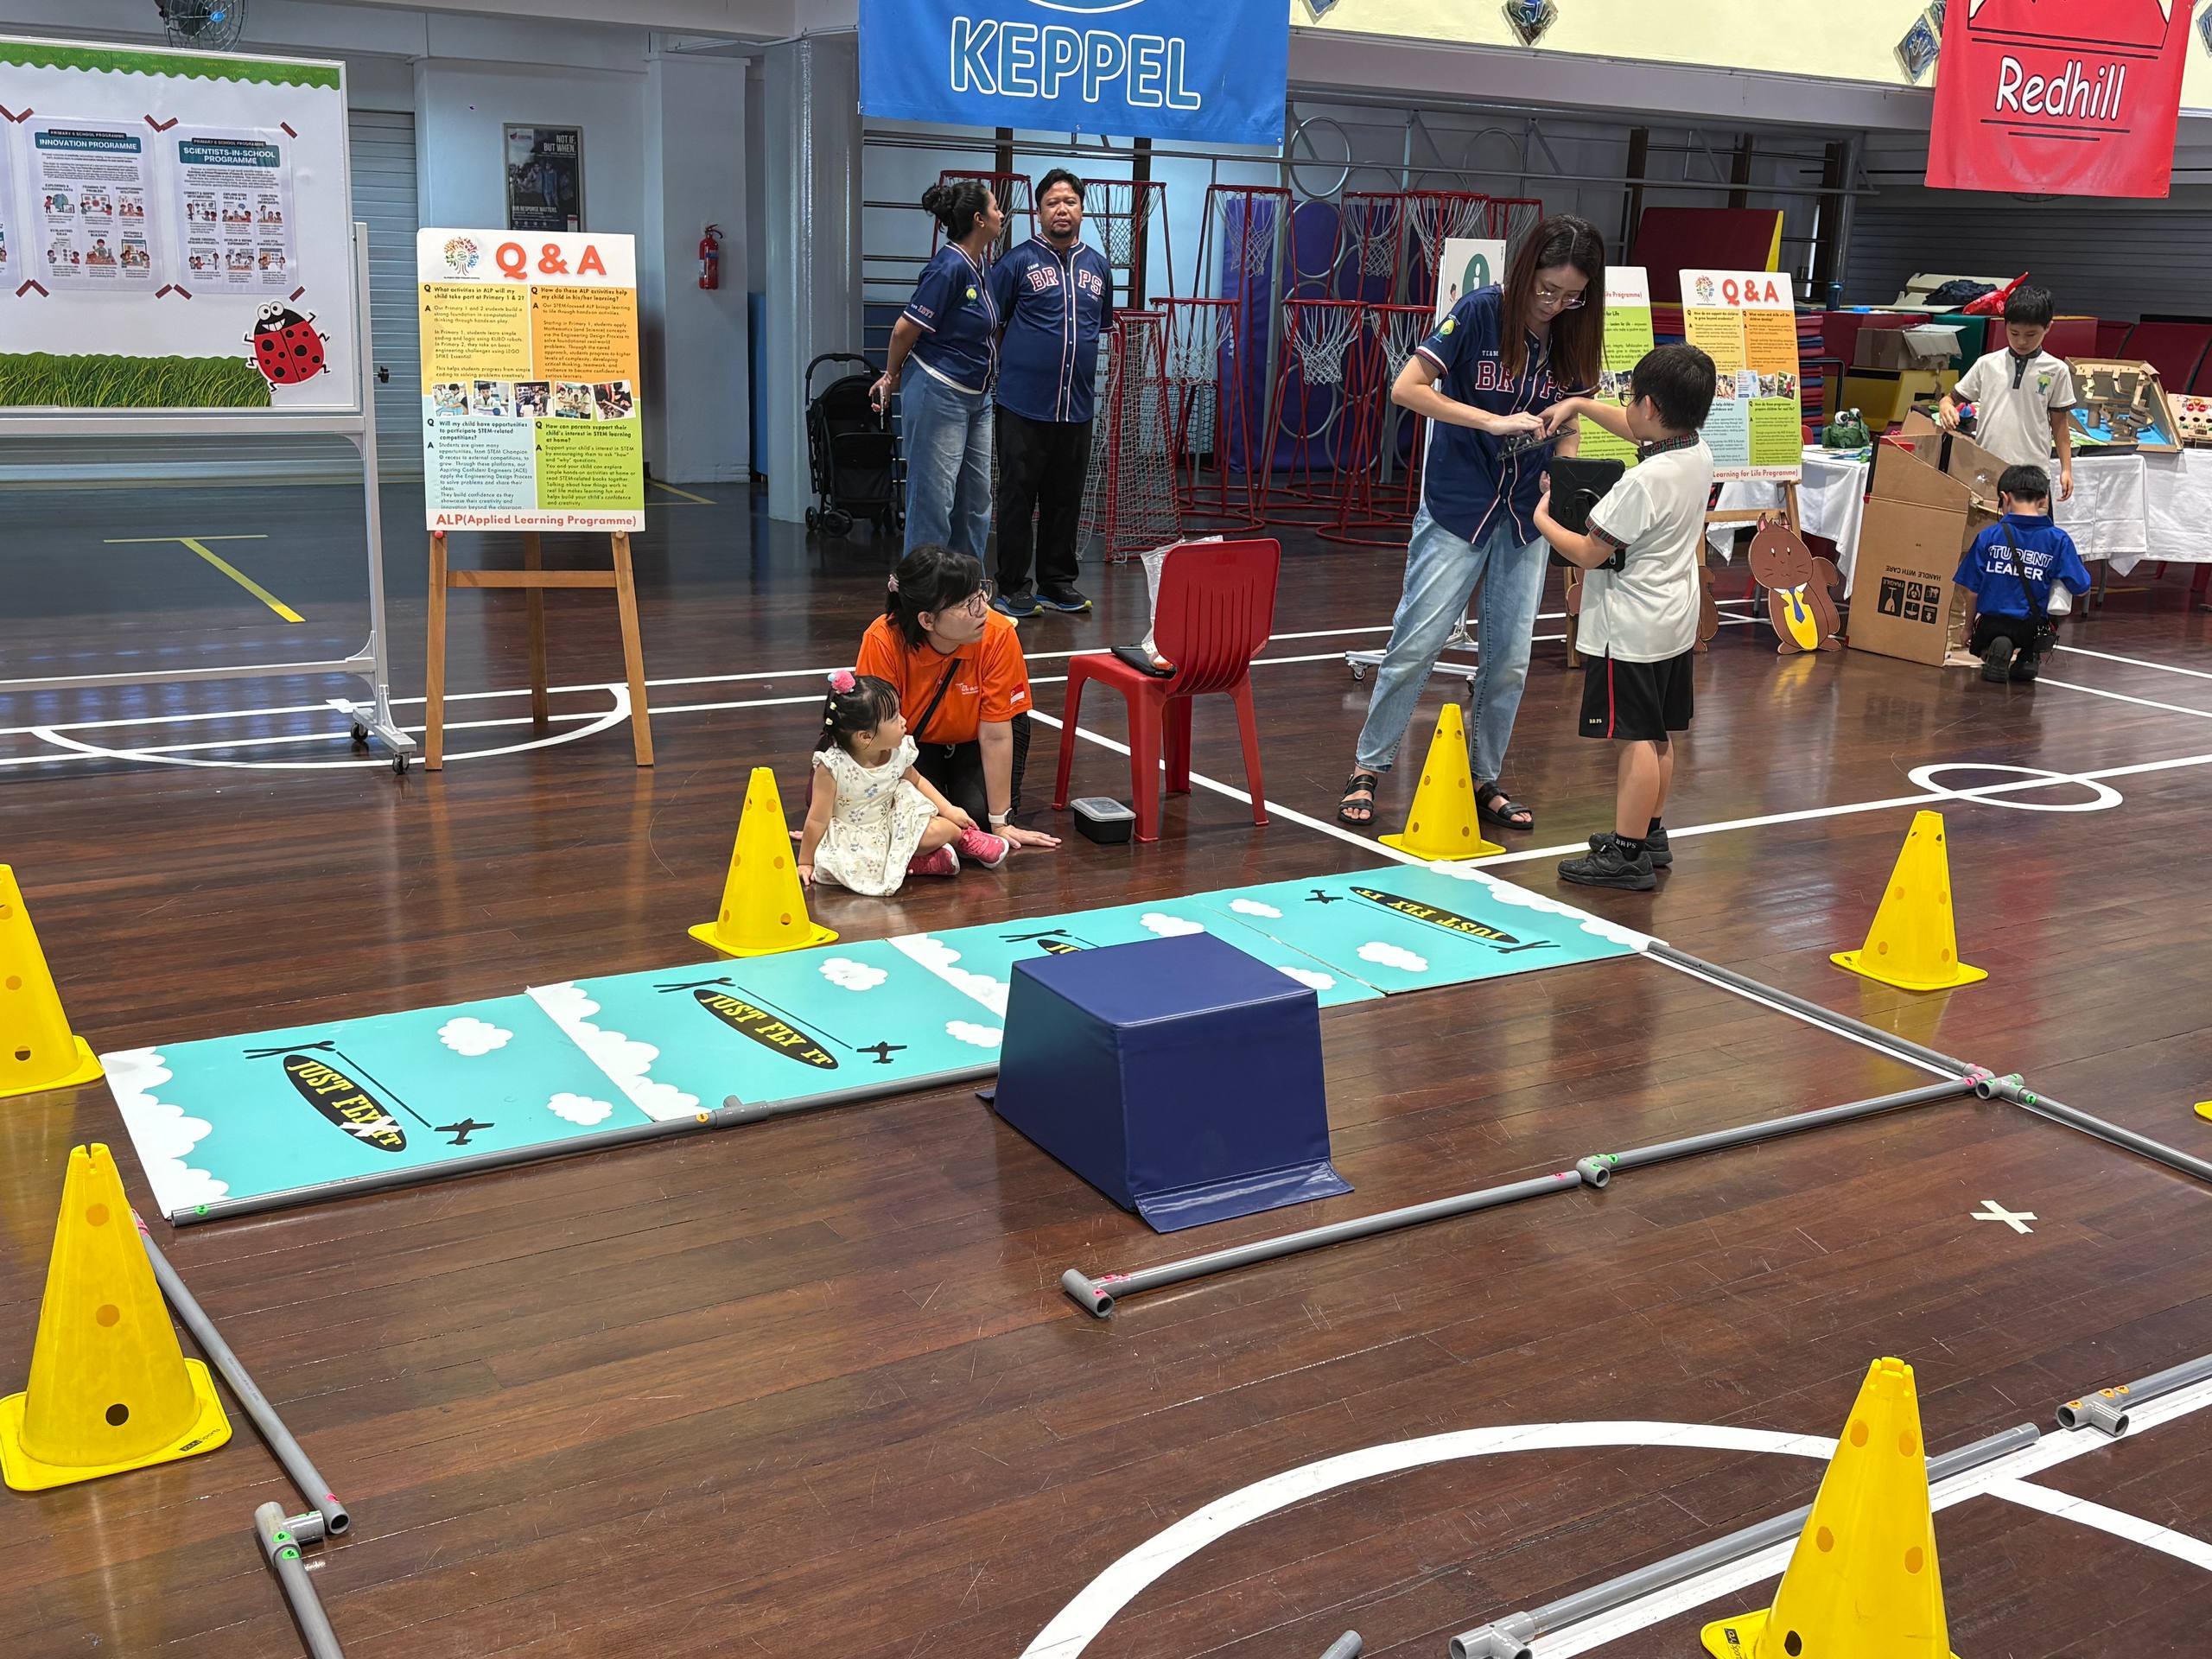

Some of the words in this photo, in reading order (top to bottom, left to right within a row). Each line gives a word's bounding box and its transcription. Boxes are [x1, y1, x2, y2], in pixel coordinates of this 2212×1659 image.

[950, 16, 1201, 111] KEPPEL
[1995, 54, 2126, 120] Redhill
[39, 138, 87, 147] INNOVATION
[88, 141, 137, 149] PROGRAMME
[183, 147, 276, 158] SCIENTISTS-IN-SCHOOL
[204, 156, 257, 164] PROGRAMME
[495, 242, 528, 279] Q
[537, 243, 569, 275] &
[576, 245, 607, 276] A
[424, 284, 431, 293] Q
[1722, 278, 1740, 306] Q
[1744, 279, 1760, 303] &
[1764, 281, 1779, 303] A
[428, 418, 435, 427] Q
[536, 421, 543, 429] Q
[514, 514, 563, 527] Learning
[568, 515, 637, 527] Programme)
[1885, 565, 1902, 574] CARE
[1917, 571, 1942, 582] HANDLE
[1884, 578, 1904, 588] FRAGILE
[1356, 889, 1385, 900] IT
[1386, 899, 1438, 918] FLY
[1435, 916, 1507, 940] JUST
[699, 994, 766, 1023] JUST
[762, 1019, 806, 1049] FLY
[800, 1046, 836, 1068] IT
[287, 1060, 354, 1096] JUST
